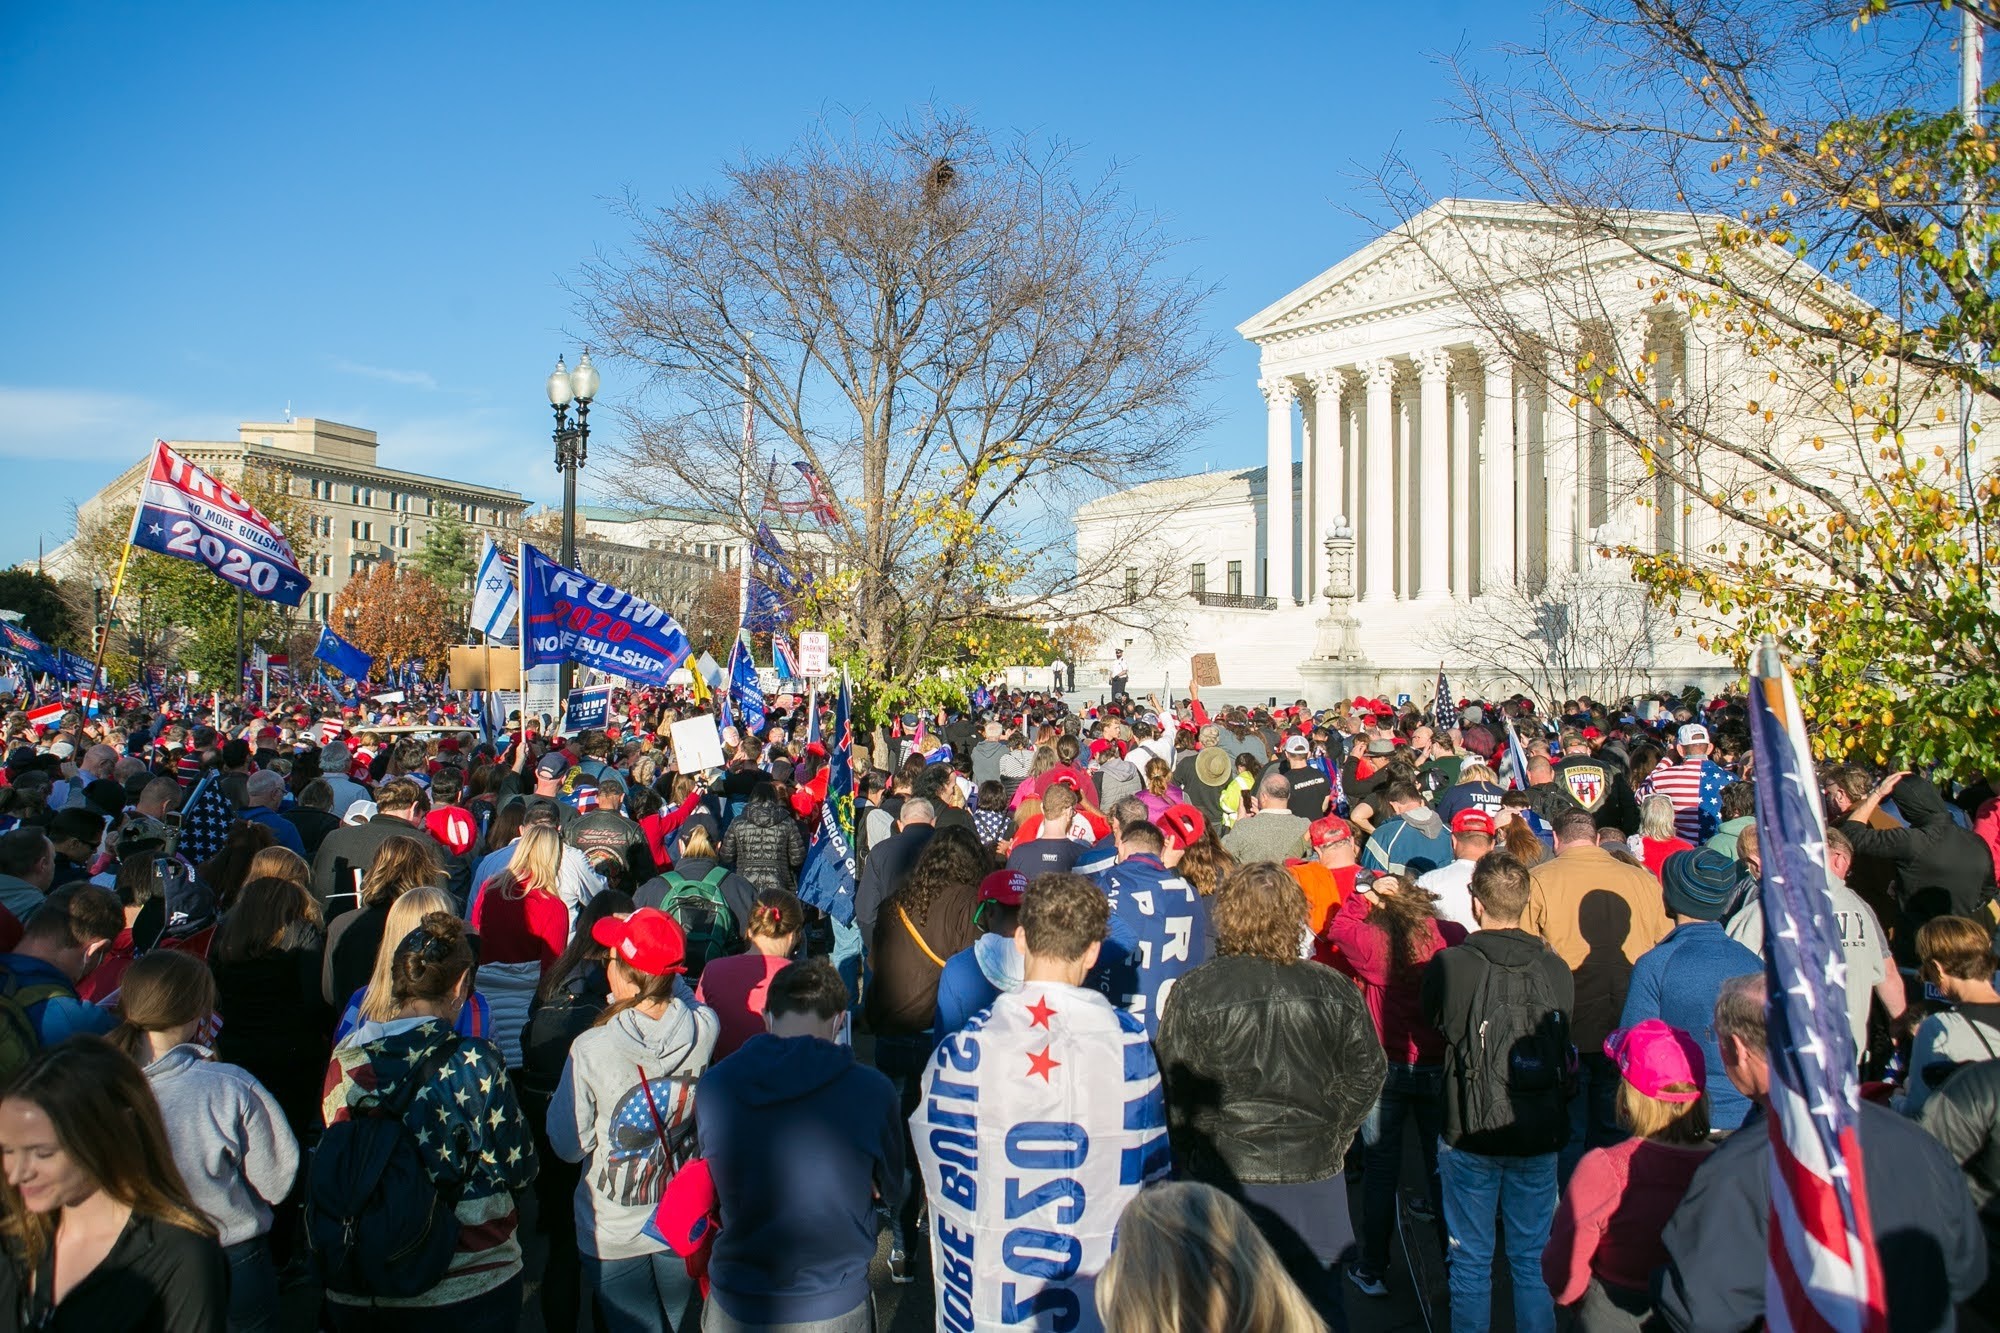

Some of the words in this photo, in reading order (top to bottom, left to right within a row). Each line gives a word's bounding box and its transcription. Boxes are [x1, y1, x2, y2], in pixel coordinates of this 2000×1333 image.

[187, 500, 201, 517] NO
[205, 508, 234, 531] MORE
[167, 520, 280, 593] 2020
[553, 600, 632, 643] 2020
[574, 636, 664, 671] BULLSHIT
[803, 645, 825, 653] PARKING
[569, 698, 607, 712] TRUMP
[571, 707, 603, 718] PENCE
[1569, 774, 1601, 782] TRUMP
[583, 829, 621, 837] Harley
[821, 802, 847, 858] MERICA
